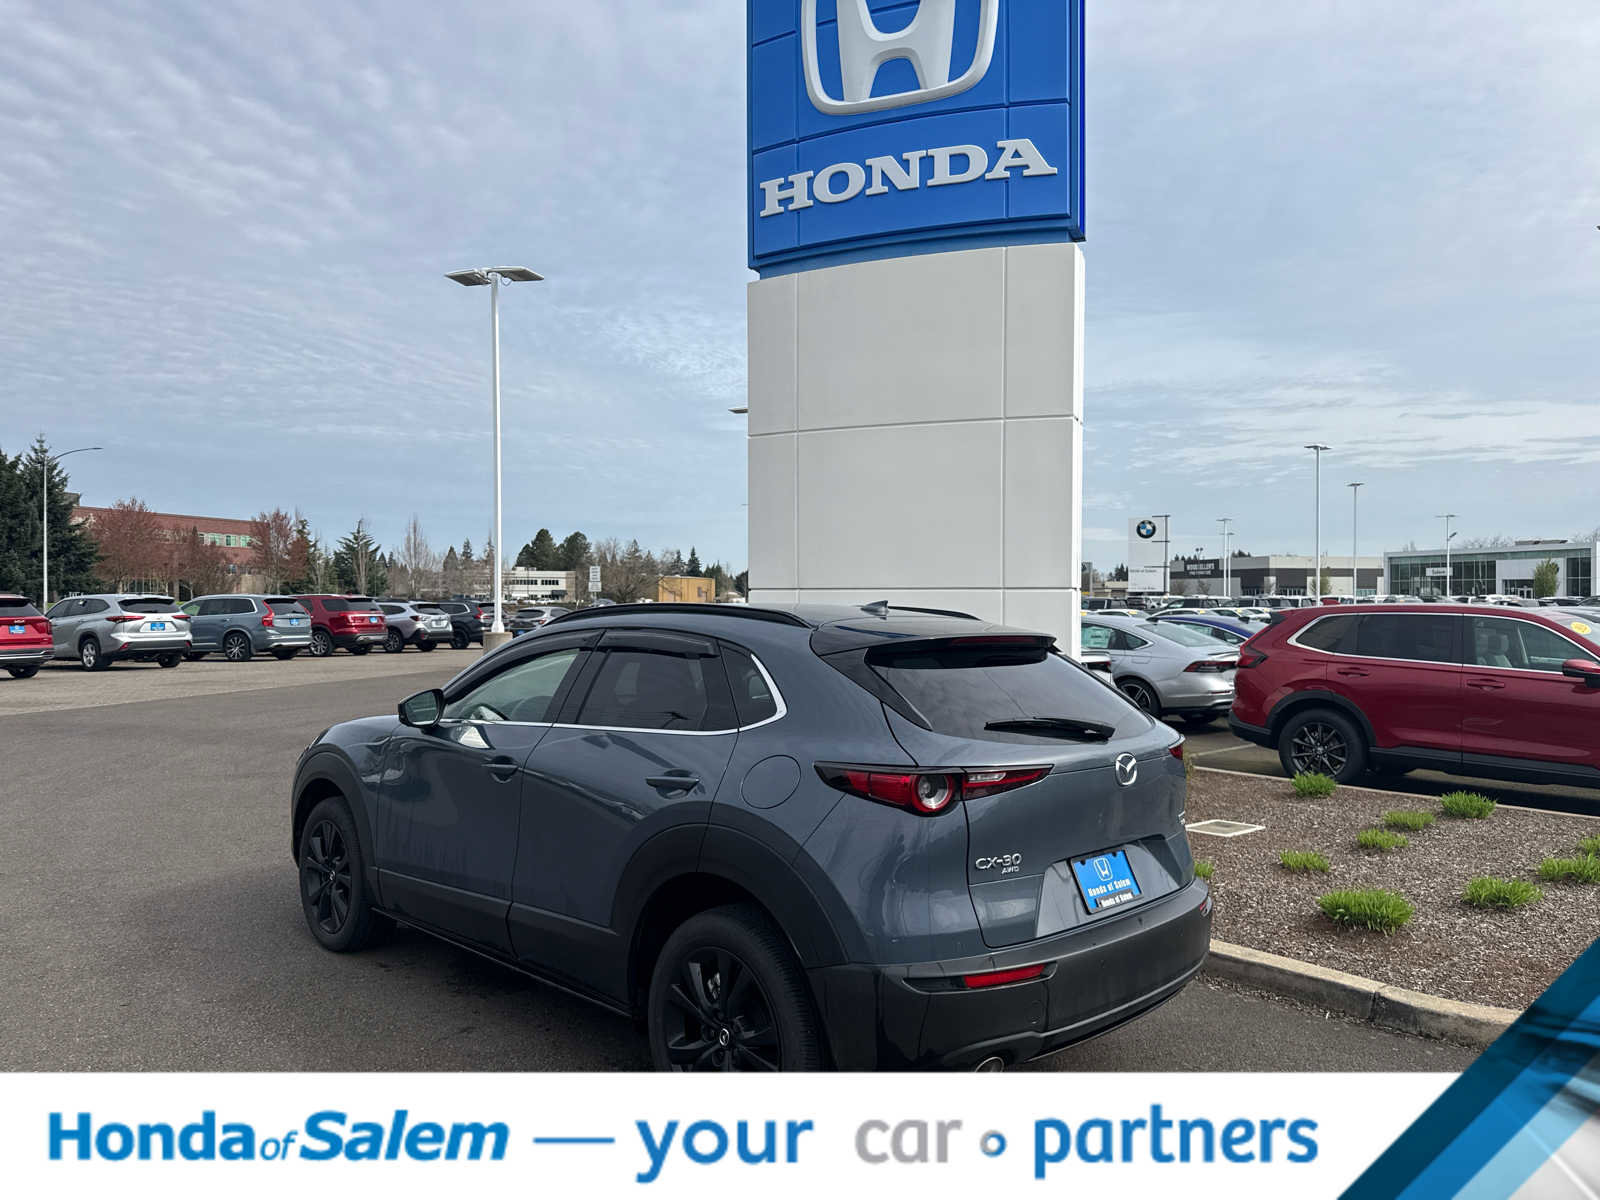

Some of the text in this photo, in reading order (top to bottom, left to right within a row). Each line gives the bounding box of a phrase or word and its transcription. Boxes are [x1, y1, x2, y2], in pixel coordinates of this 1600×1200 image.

[759, 138, 1058, 218] HONDA
[975, 852, 1022, 870] CX-30
[1001, 865, 1020, 875] AWD
[1087, 884, 1107, 897] Honda
[1113, 878, 1131, 890] Salem
